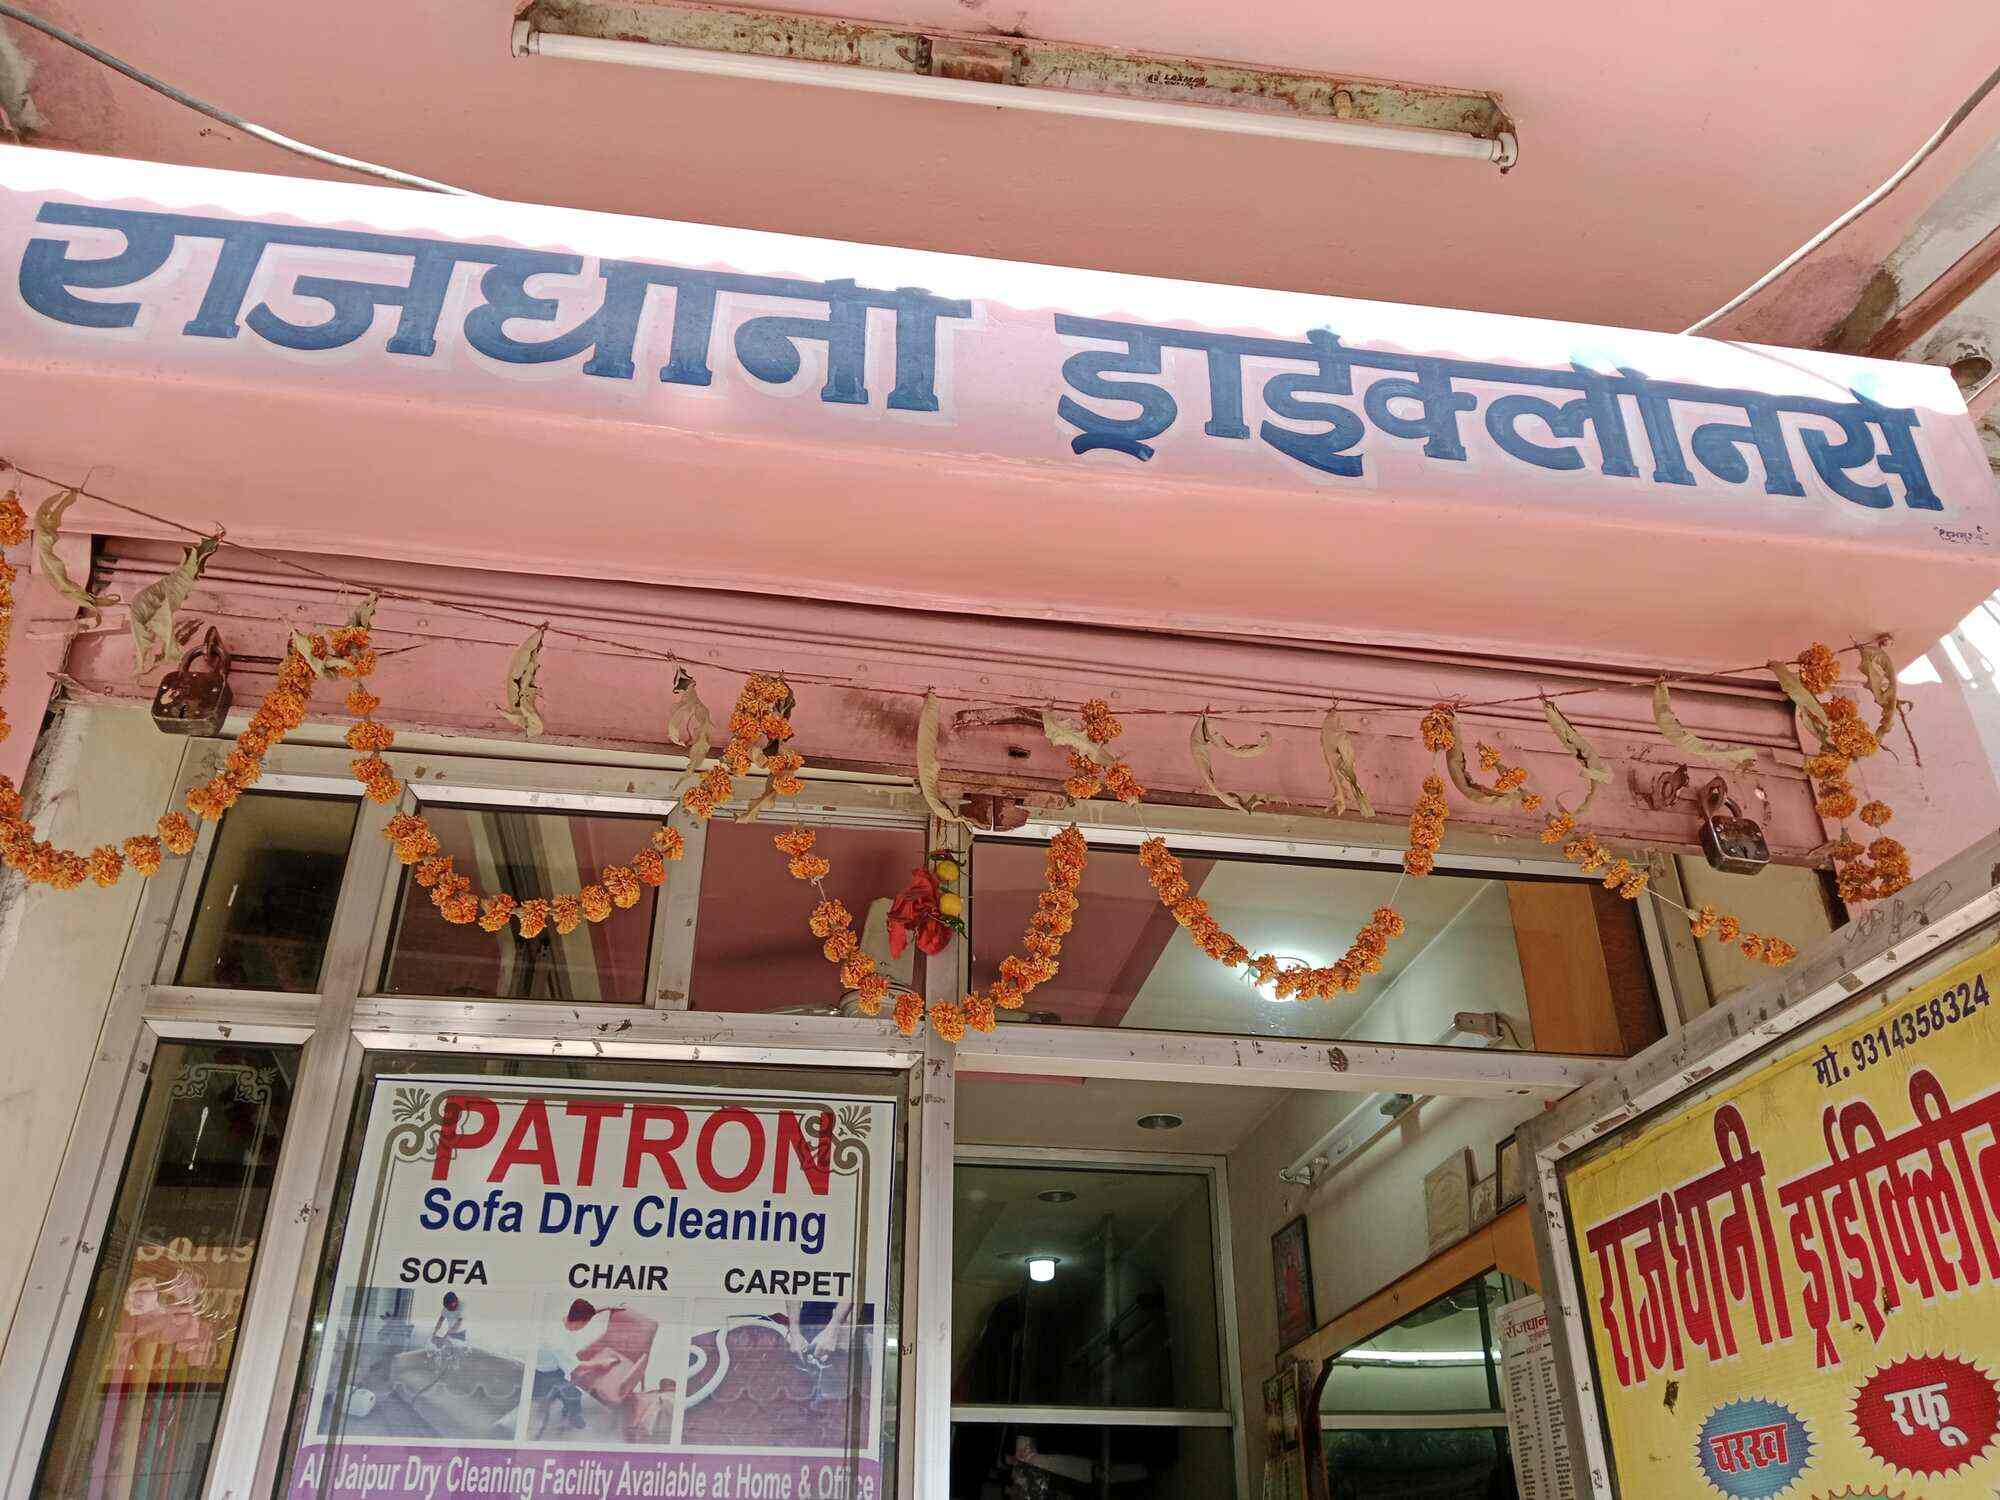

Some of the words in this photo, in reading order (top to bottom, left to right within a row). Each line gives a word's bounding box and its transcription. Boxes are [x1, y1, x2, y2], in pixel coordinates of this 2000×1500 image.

[1851, 973, 1990, 1071] 9314358324
[430, 1095, 836, 1195] PATRON
[420, 1187, 522, 1233] Sofa
[537, 1192, 618, 1247] Dry
[634, 1196, 826, 1255] Cleaning
[1586, 1104, 1793, 1386] राजधानी
[400, 1257, 489, 1285] SOFA
[568, 1263, 669, 1292] CHAIR
[725, 1268, 851, 1297] CARPET
[1884, 1382, 1969, 1447] रफू
[298, 1453, 332, 1489] Al
[334, 1454, 400, 1498] Jaipur
[404, 1456, 441, 1500] Dry
[446, 1456, 535, 1500] Cleaning
[540, 1458, 614, 1500] Facility
[616, 1461, 707, 1498] Available
[711, 1466, 731, 1499] at
[735, 1464, 792, 1499] Home
[798, 1465, 812, 1499] &
